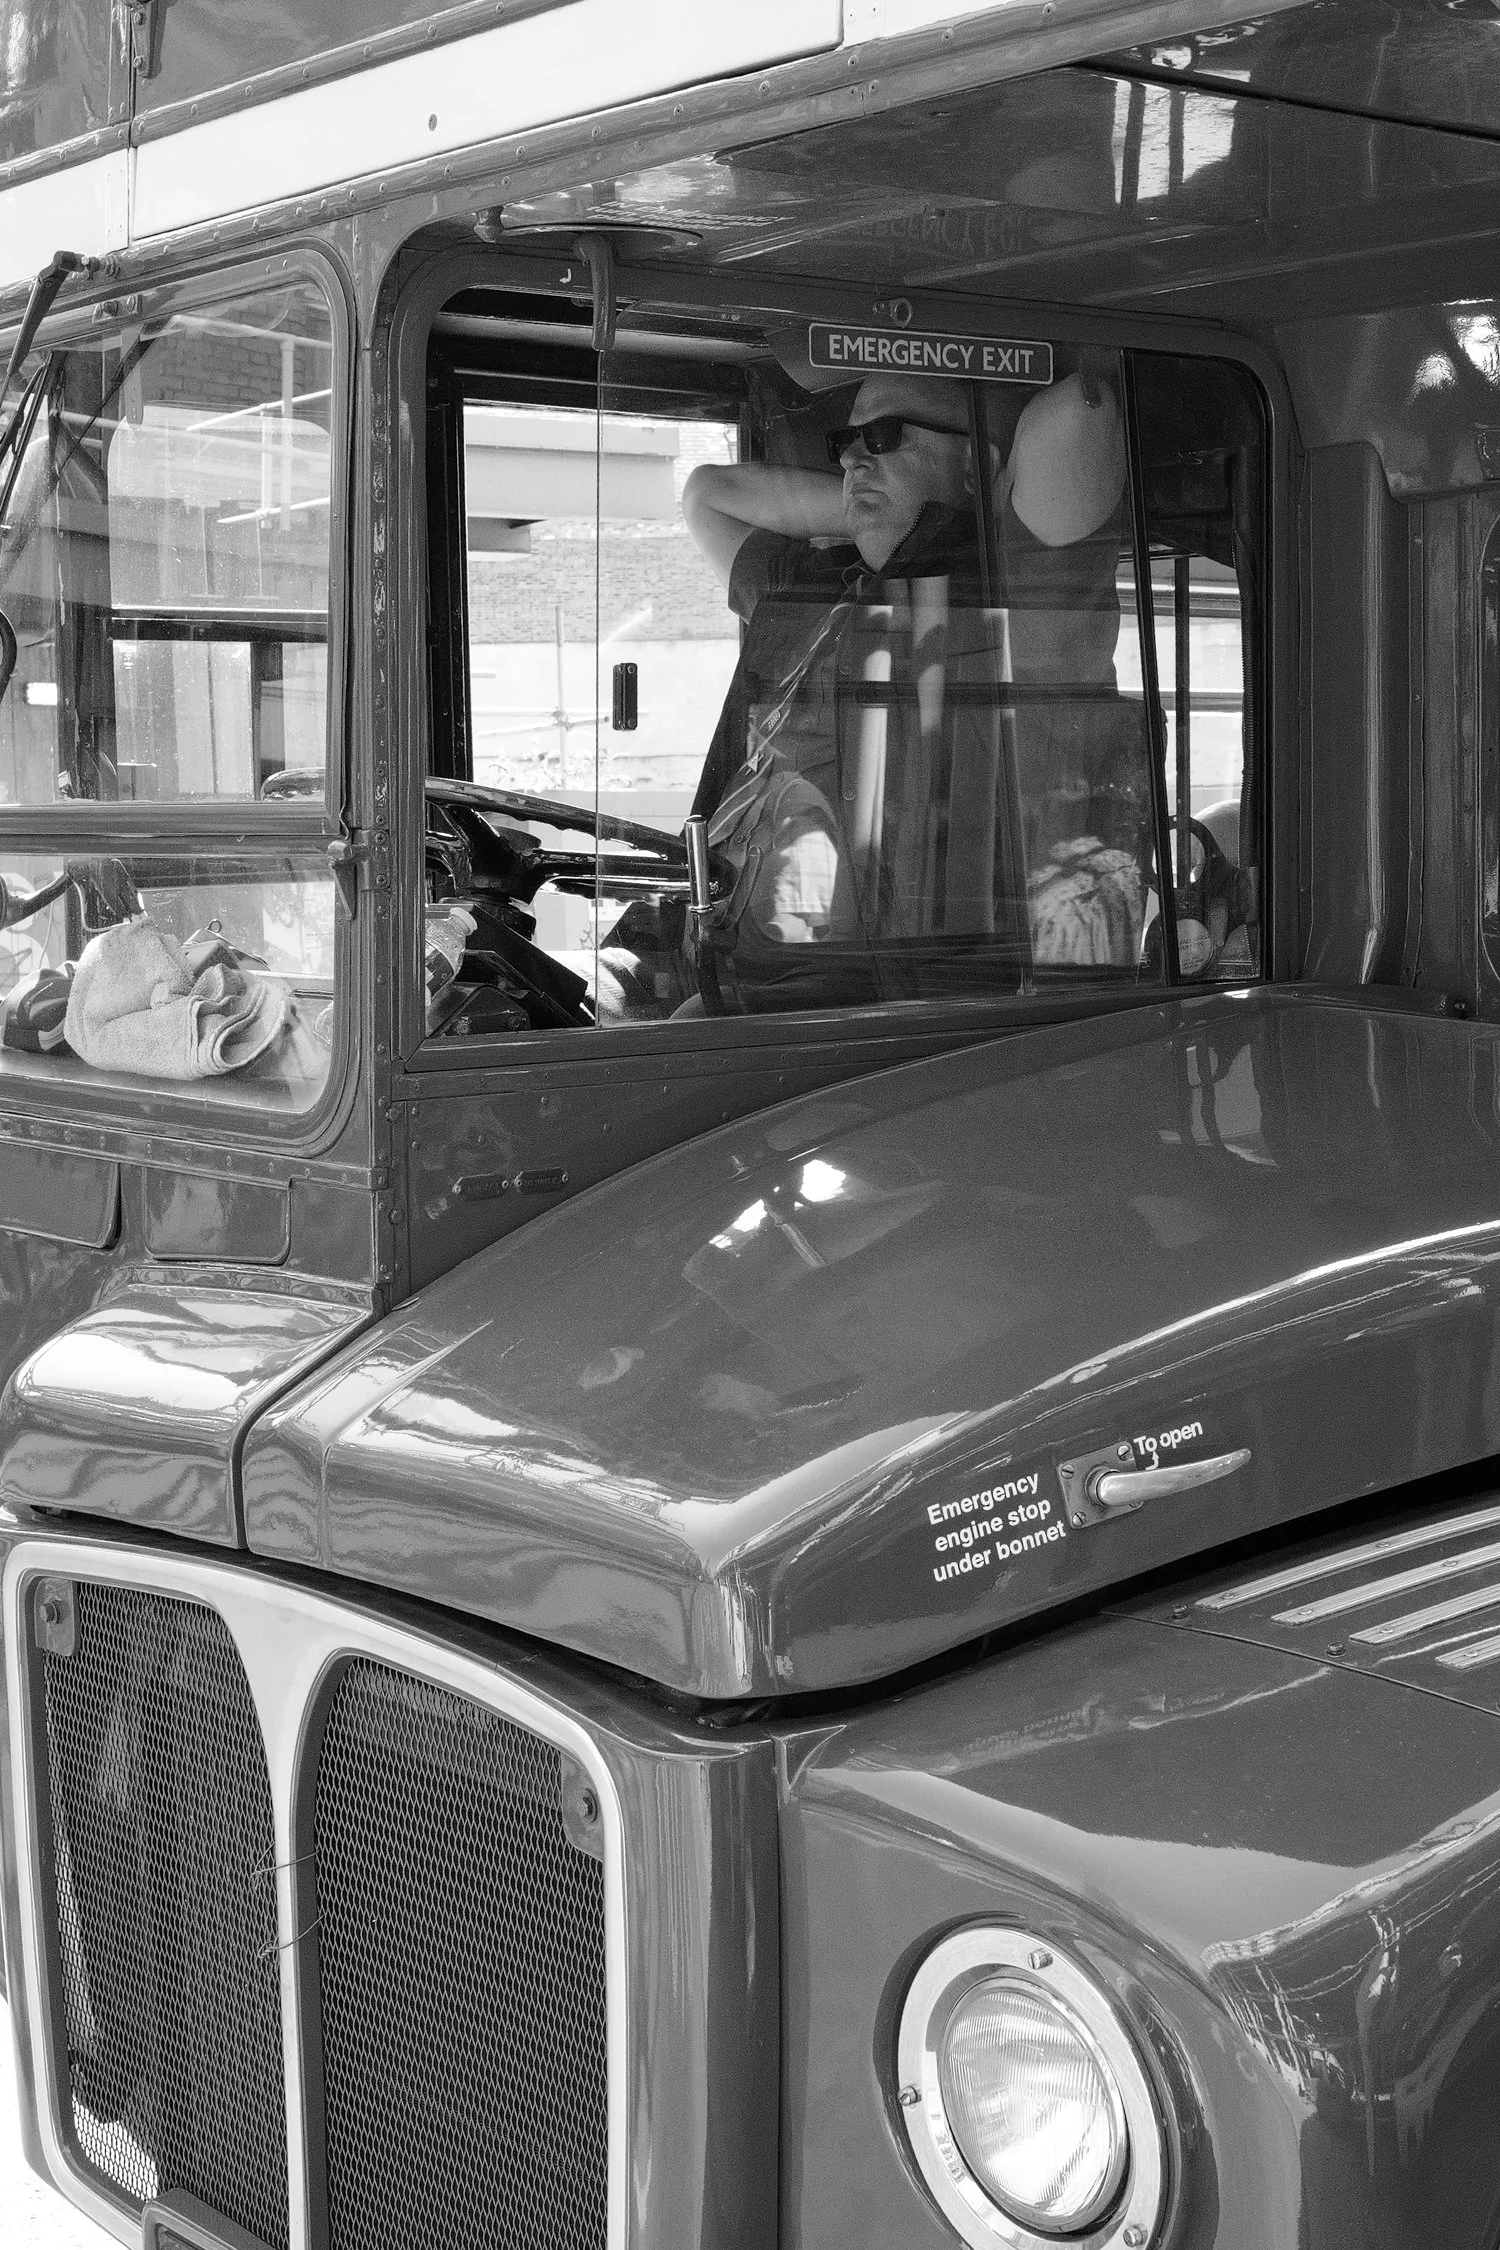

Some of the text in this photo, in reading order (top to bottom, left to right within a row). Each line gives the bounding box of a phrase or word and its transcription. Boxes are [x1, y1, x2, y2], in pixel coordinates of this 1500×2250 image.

[828, 334, 1034, 374] EMERGENCY EXIT
[1133, 1421, 1204, 1455] To open
[926, 1473, 1039, 1525] Emergency
[933, 1520, 1067, 1582] under bonnet
[935, 1499, 1051, 1552] engine stop
